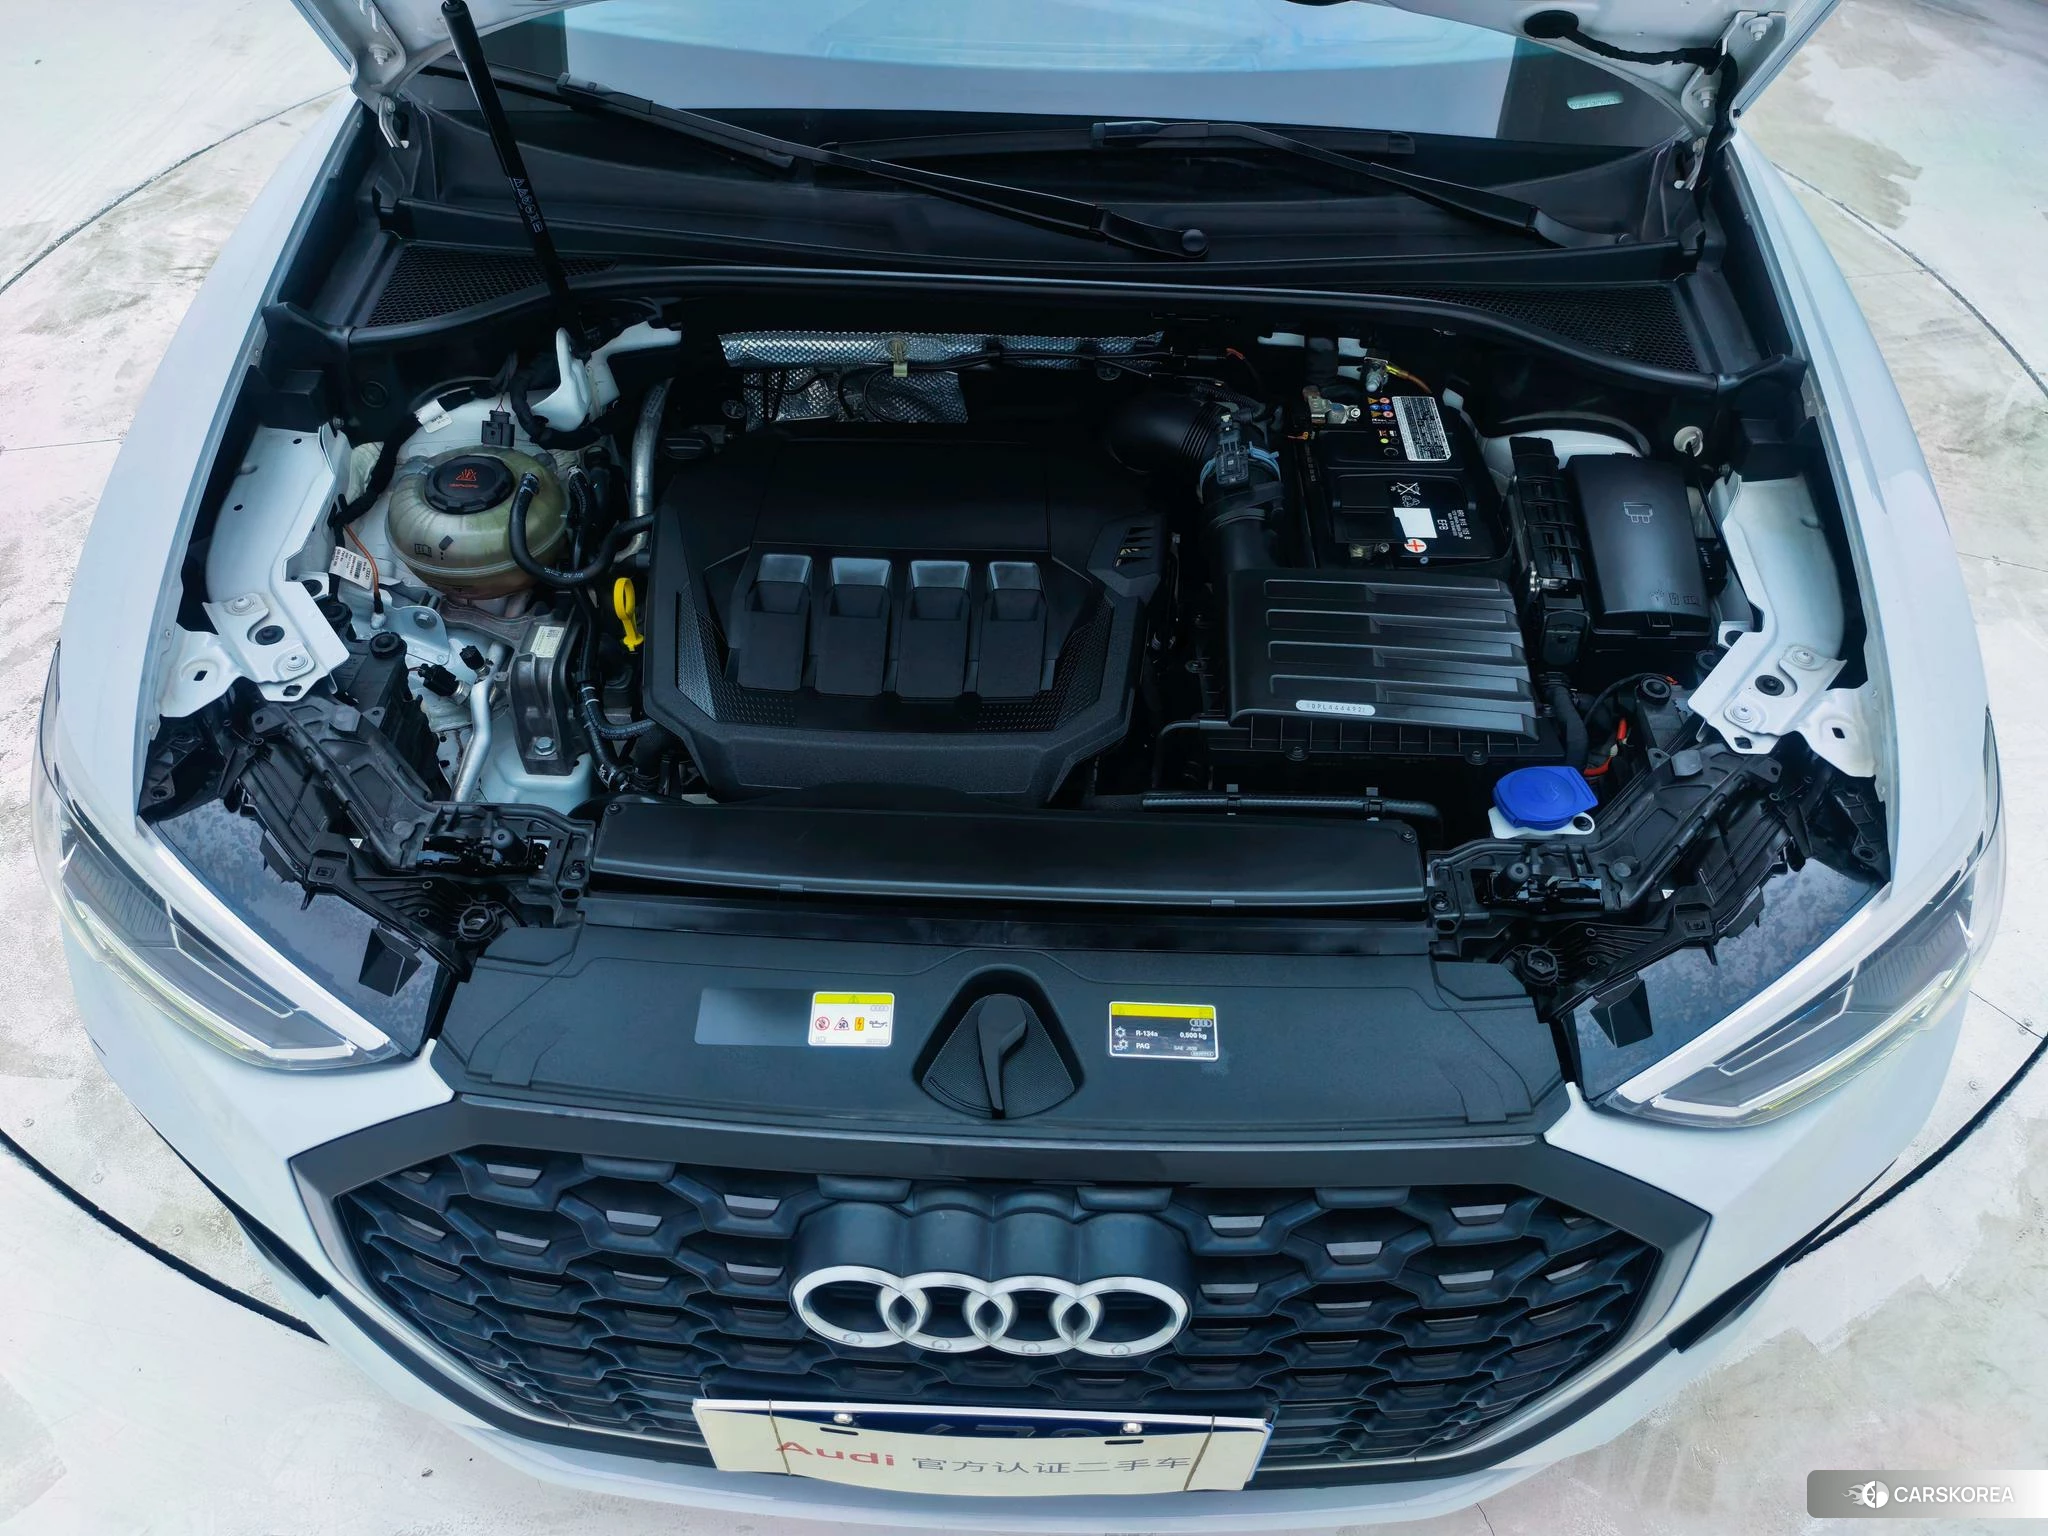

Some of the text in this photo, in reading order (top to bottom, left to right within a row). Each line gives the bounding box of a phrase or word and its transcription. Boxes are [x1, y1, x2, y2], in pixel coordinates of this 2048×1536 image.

[1198, 1032, 1207, 1040] kg
[1135, 1042, 1150, 1050] PAG
[776, 1441, 1191, 1474] Audi 官方认证二手车
